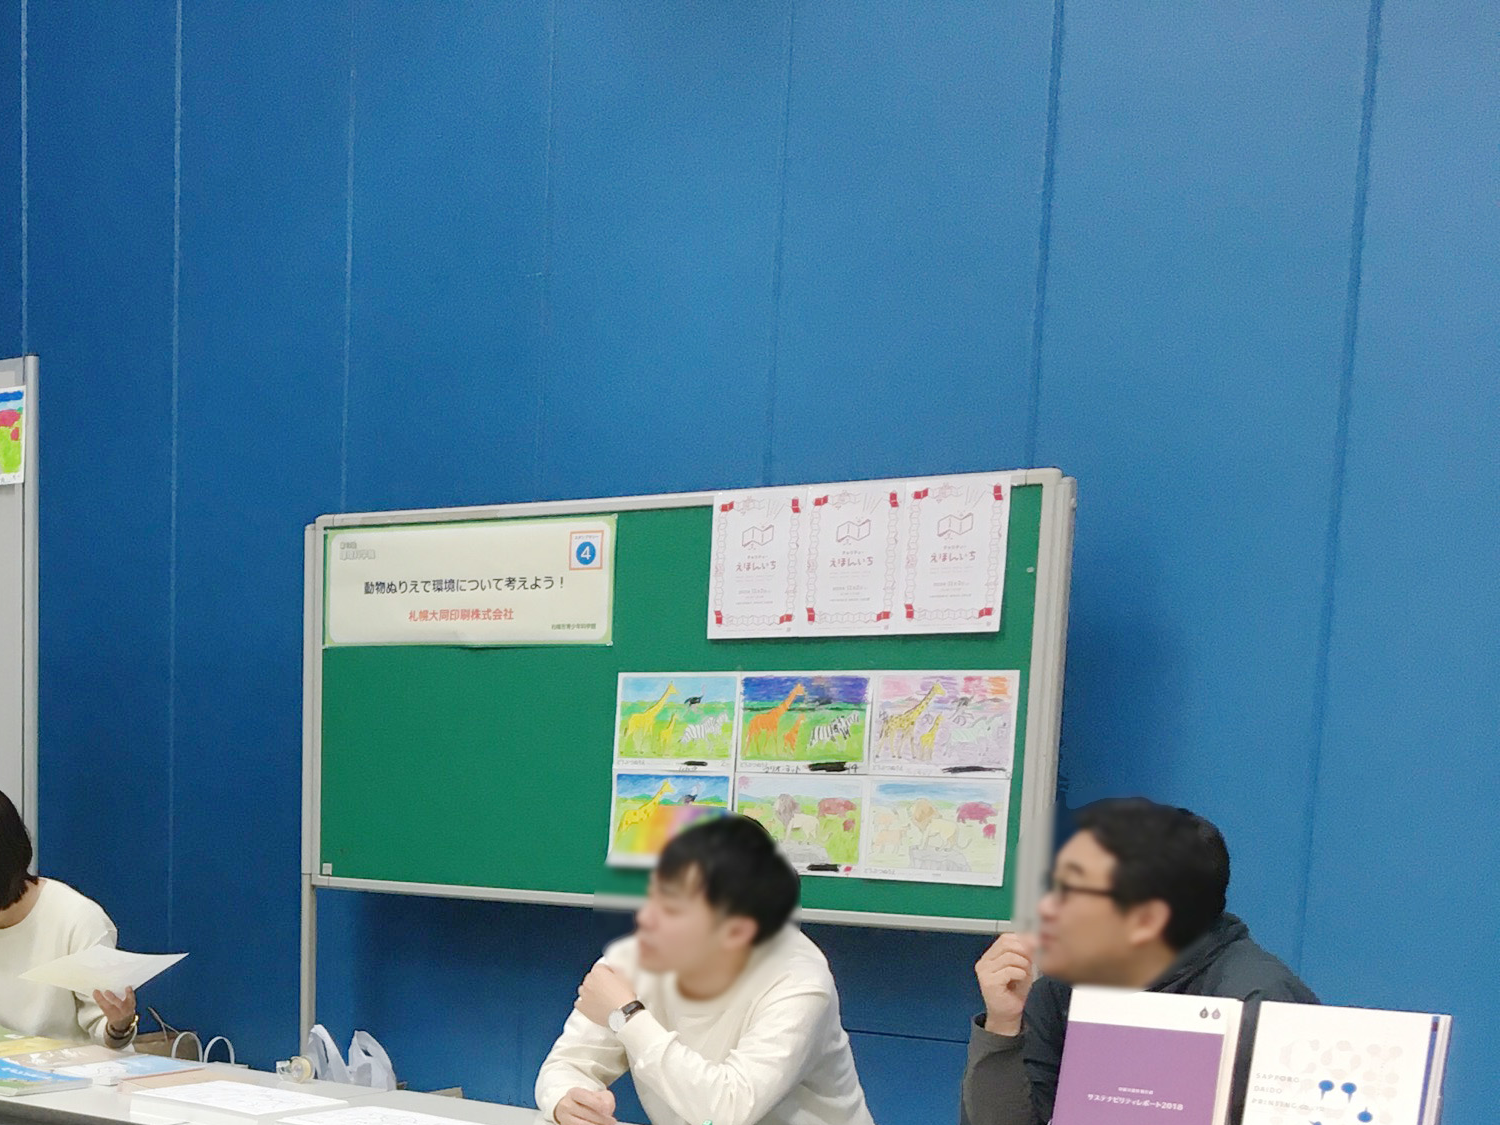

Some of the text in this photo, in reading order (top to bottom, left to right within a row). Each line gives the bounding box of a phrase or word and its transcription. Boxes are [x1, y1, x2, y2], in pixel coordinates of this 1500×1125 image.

[580, 546, 592, 560] 4
[930, 551, 976, 562] えほんいち
[736, 560, 776, 572] えほんいち
[829, 556, 873, 567] えほんいち
[364, 576, 564, 595] 動物ぬりえで環境について考えよう！
[408, 608, 514, 622] 札幌大同印刷株式会社
[1256, 1072, 1300, 1083] SAPPORO
[1254, 1085, 1283, 1094] DAIDO
[1087, 1093, 1183, 1111] サステナビリティレポート2018
